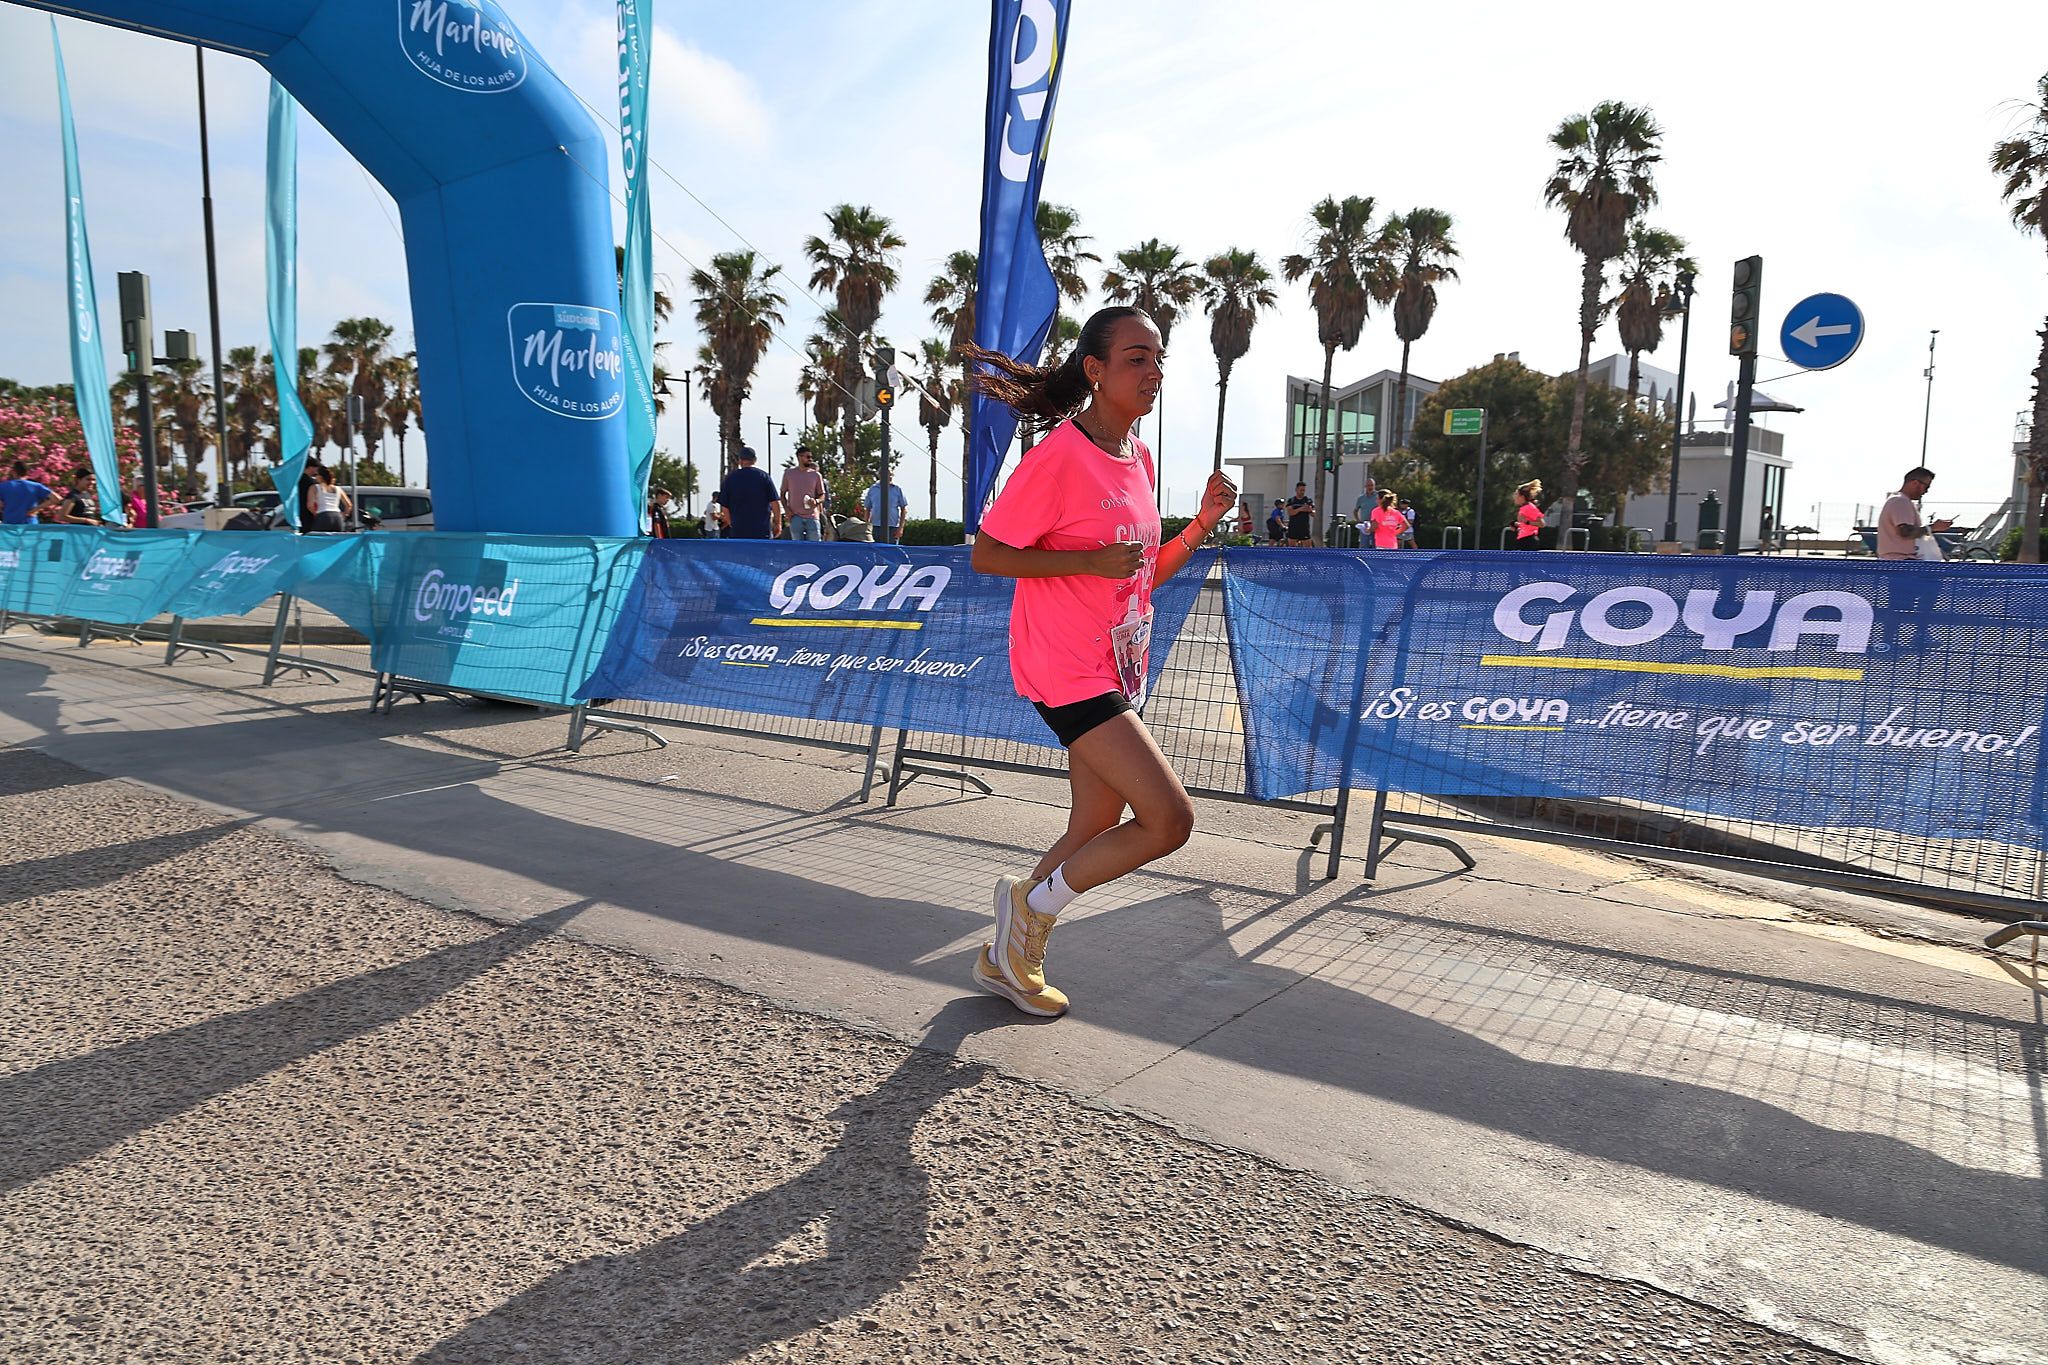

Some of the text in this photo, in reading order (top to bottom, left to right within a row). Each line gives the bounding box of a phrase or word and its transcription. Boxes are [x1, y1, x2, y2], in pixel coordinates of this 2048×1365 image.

[410, 0, 516, 59] Marlene
[417, 50, 516, 86] HIJA DE LOS ALPES
[524, 329, 622, 388] Marlene
[533, 385, 621, 412] HIJA DE LOS ALPES
[414, 568, 520, 622] Compeed
[769, 563, 952, 615] GOYA
[1493, 581, 1875, 654] GOYA
[725, 644, 779, 662] GOYA
[830, 652, 864, 681] que
[867, 653, 904, 672] ser
[902, 647, 984, 679] bueno!
[1462, 696, 1570, 723] GOYA
[1695, 715, 1775, 756] que
[1782, 721, 1857, 745] ser
[1865, 706, 2038, 756] bueno!
